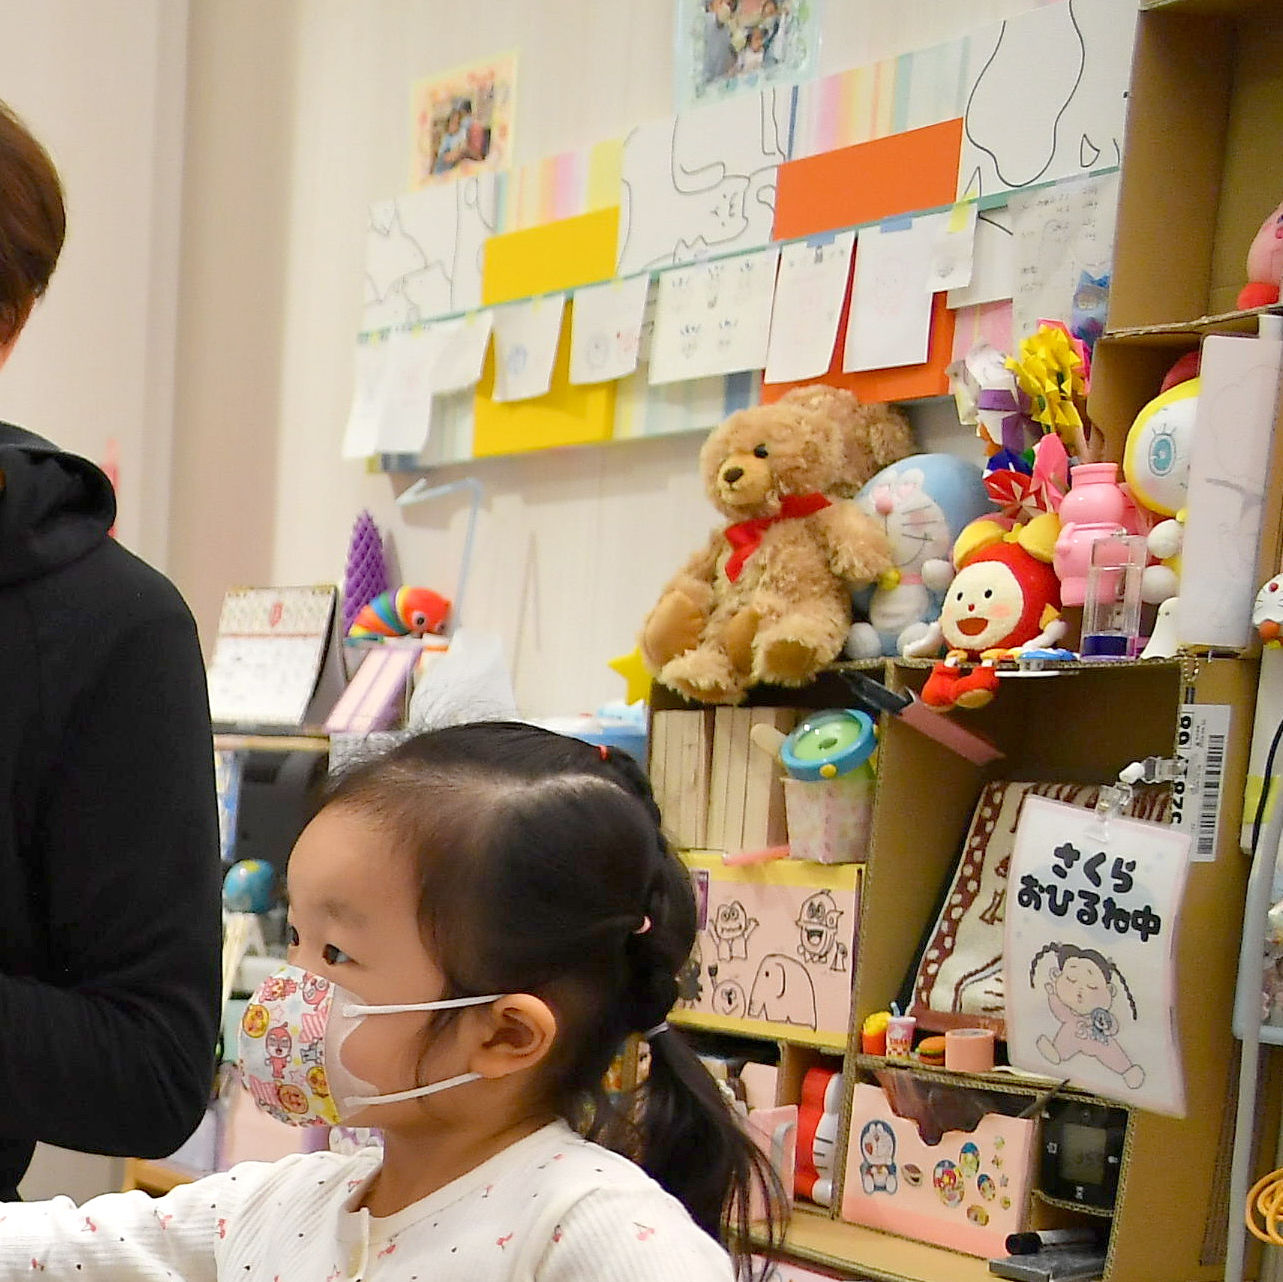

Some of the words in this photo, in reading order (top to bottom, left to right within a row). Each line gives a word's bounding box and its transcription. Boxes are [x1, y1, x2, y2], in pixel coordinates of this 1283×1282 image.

[1052, 842, 1136, 893] さくら
[1018, 874, 1161, 942] おひるね中
